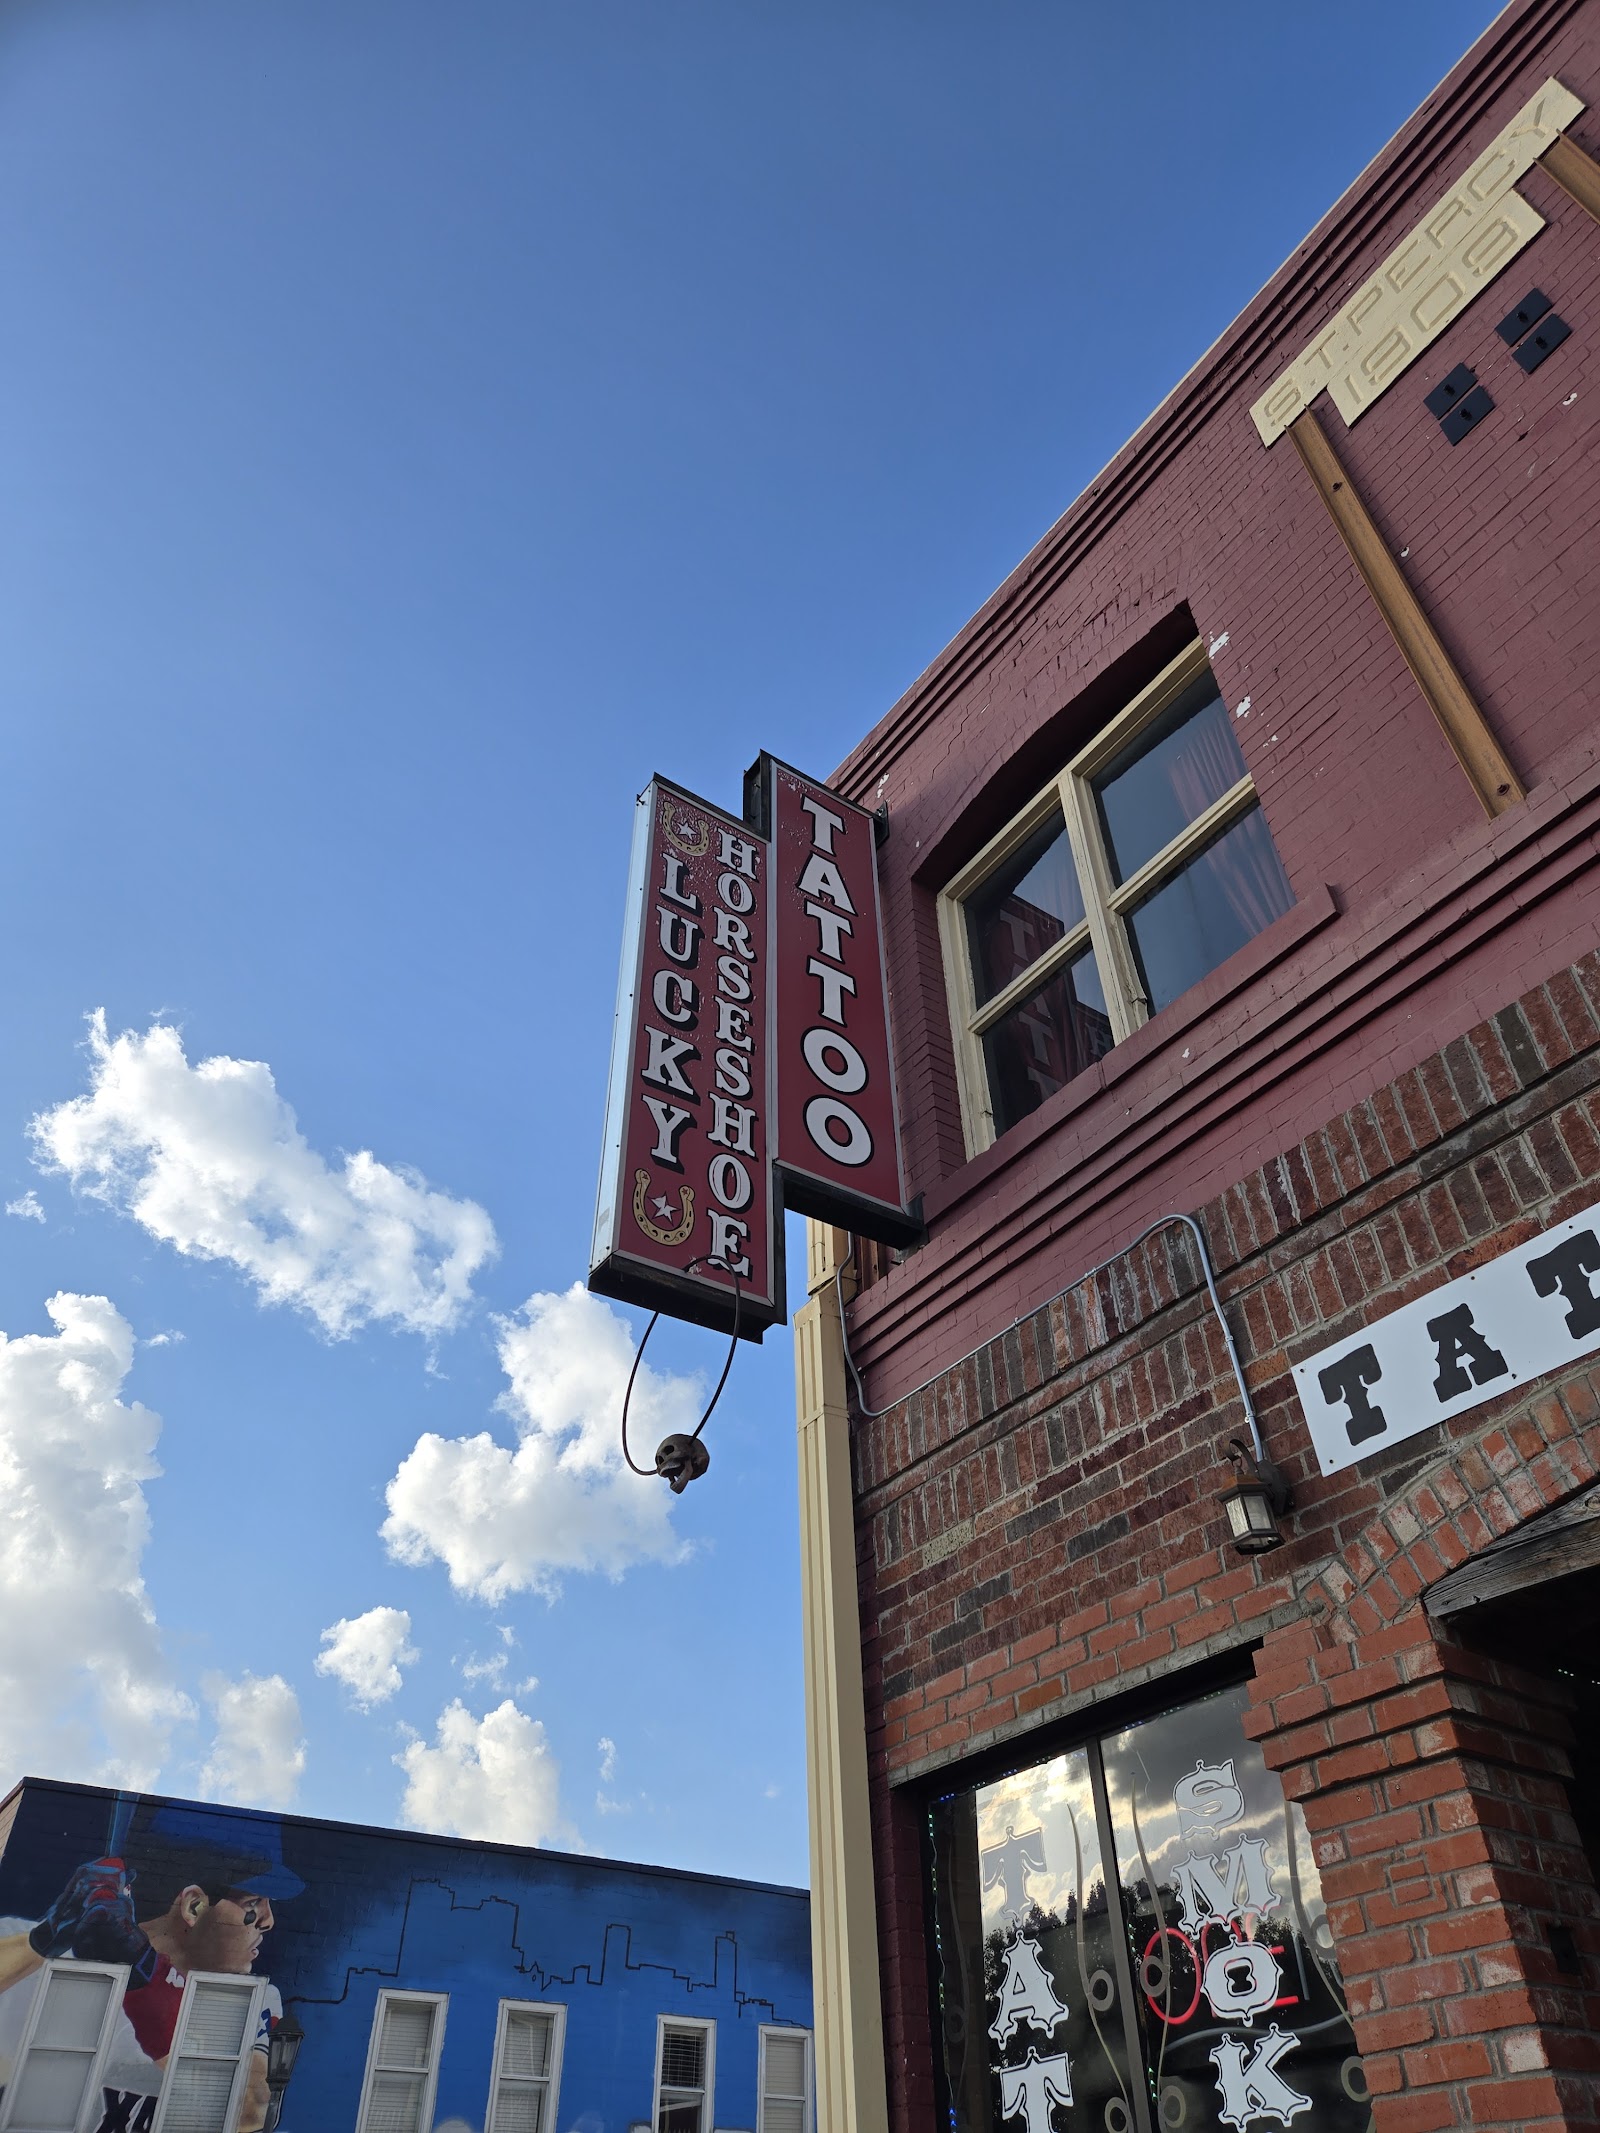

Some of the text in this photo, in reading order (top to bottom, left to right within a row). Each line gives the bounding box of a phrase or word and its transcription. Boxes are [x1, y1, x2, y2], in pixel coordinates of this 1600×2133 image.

[1344, 216, 1519, 405] 1909
[641, 852, 700, 1174] LUCKY
[706, 826, 757, 1281] HORSESHOE
[800, 794, 873, 1167] TATTOO
